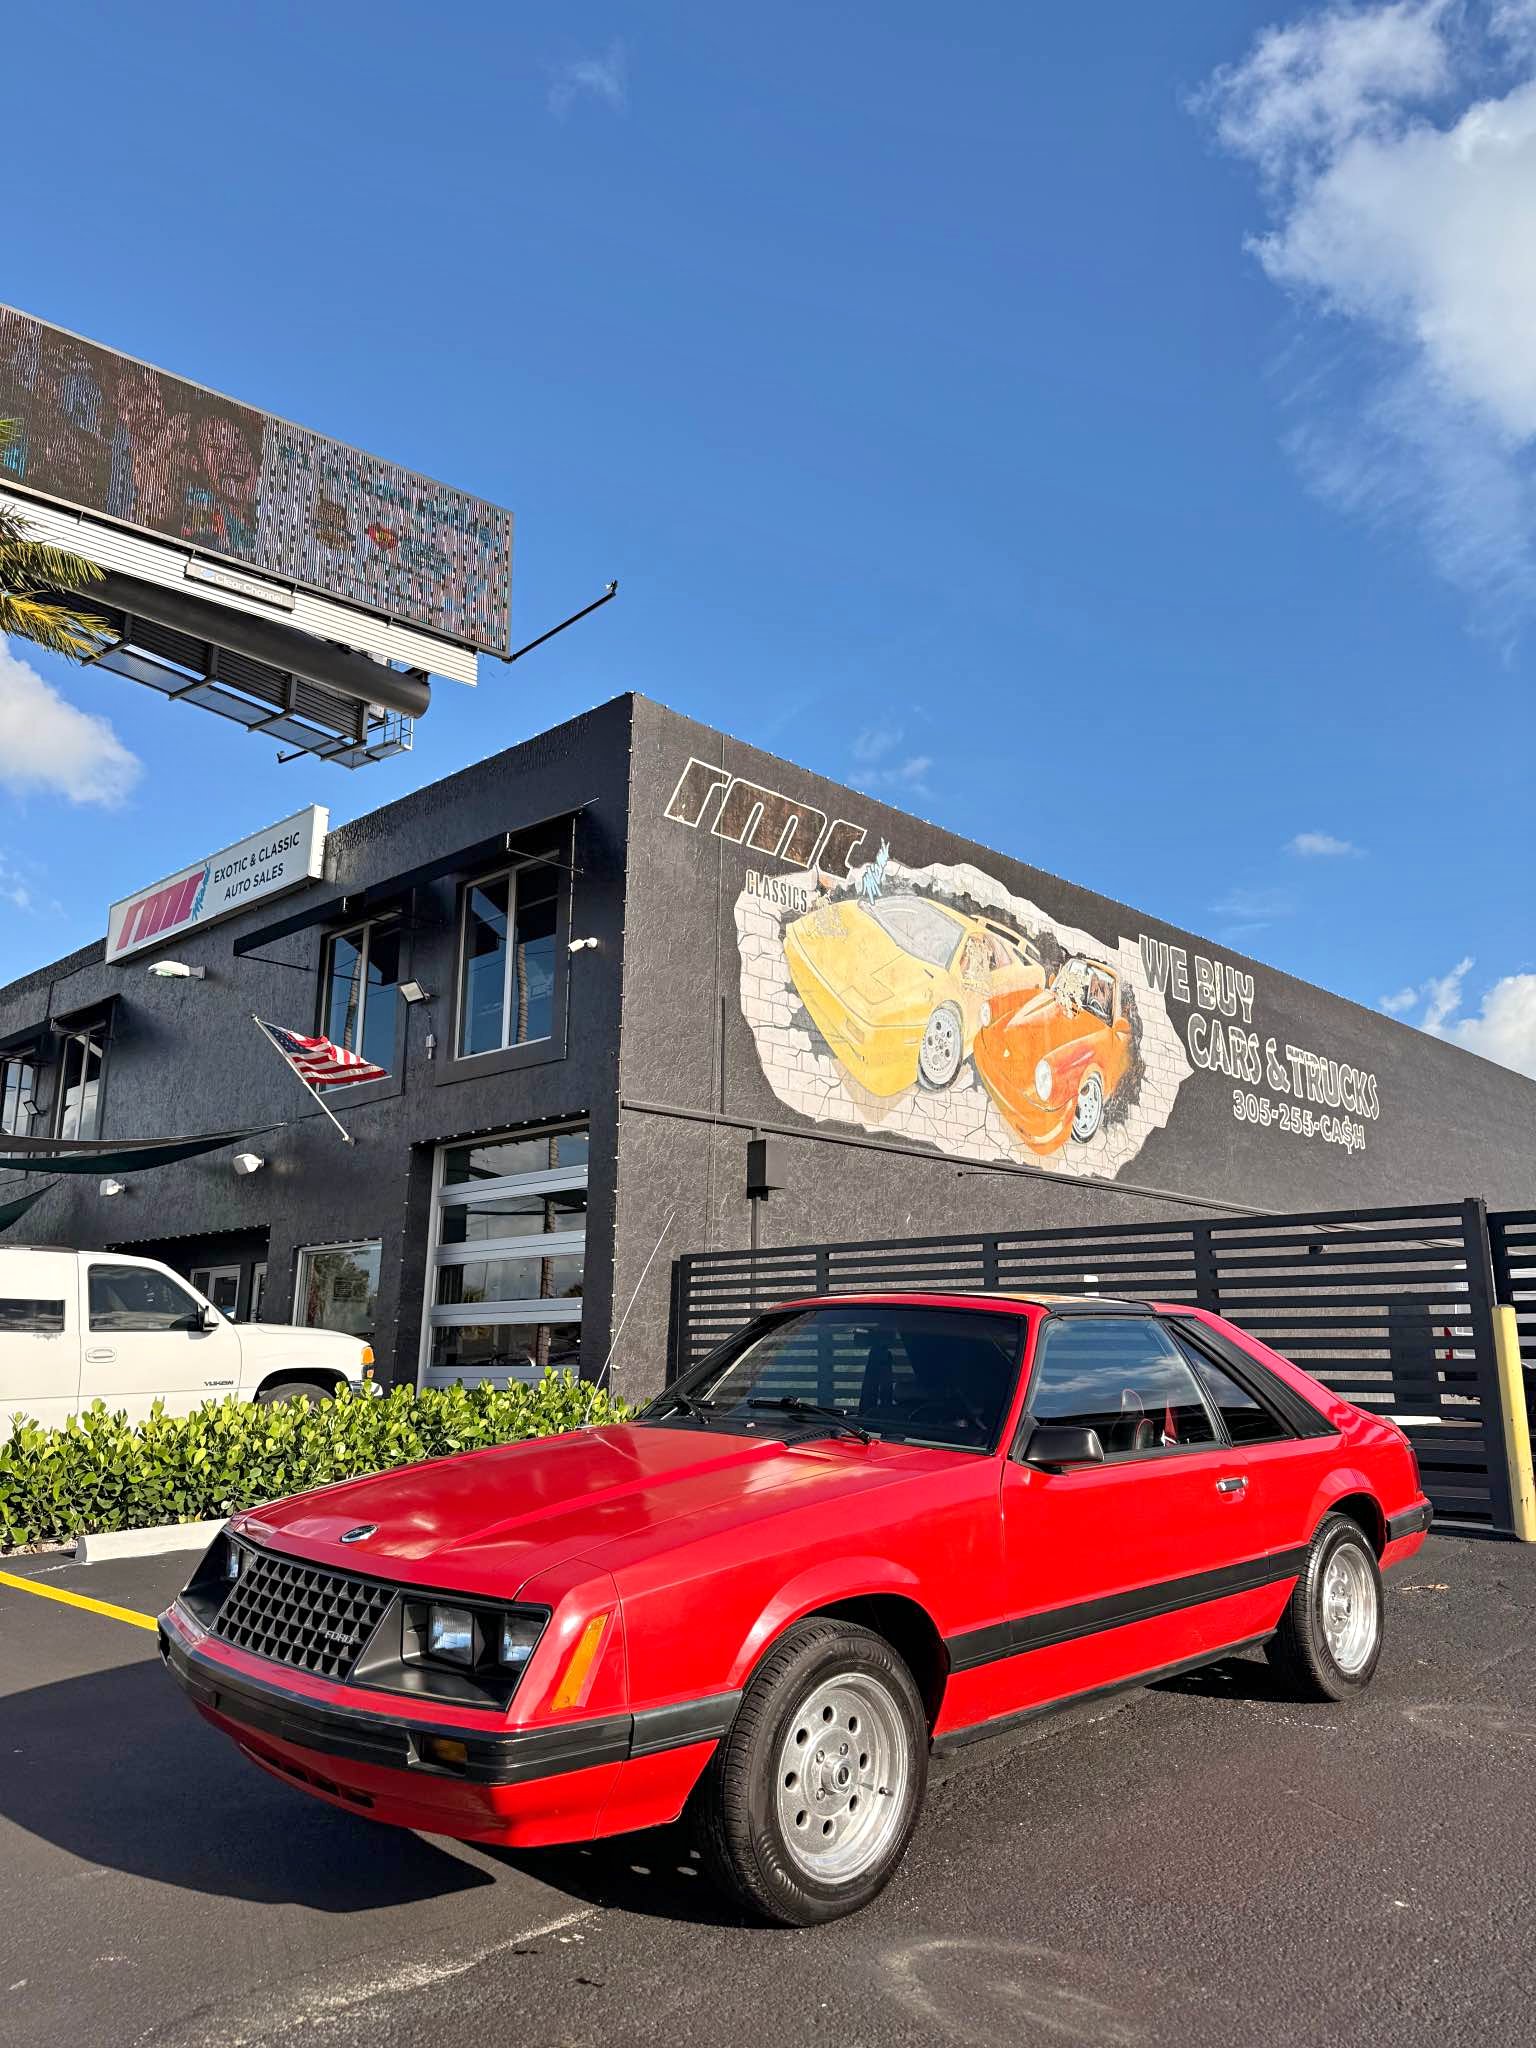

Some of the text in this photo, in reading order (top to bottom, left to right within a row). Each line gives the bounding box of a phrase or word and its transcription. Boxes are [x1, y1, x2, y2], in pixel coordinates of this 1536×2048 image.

[215, 573, 284, 605] Clear Channel
[214, 831, 300, 884] EXOTIC & CLASSIC
[224, 879, 251, 901] AUTO
[252, 862, 284, 889] SALES
[745, 868, 808, 914] CLASSICS
[1138, 933, 1255, 1024] WE BUY
[1187, 1012, 1380, 1121] CARS & TRUCKS
[325, 1630, 354, 1645] FORD
